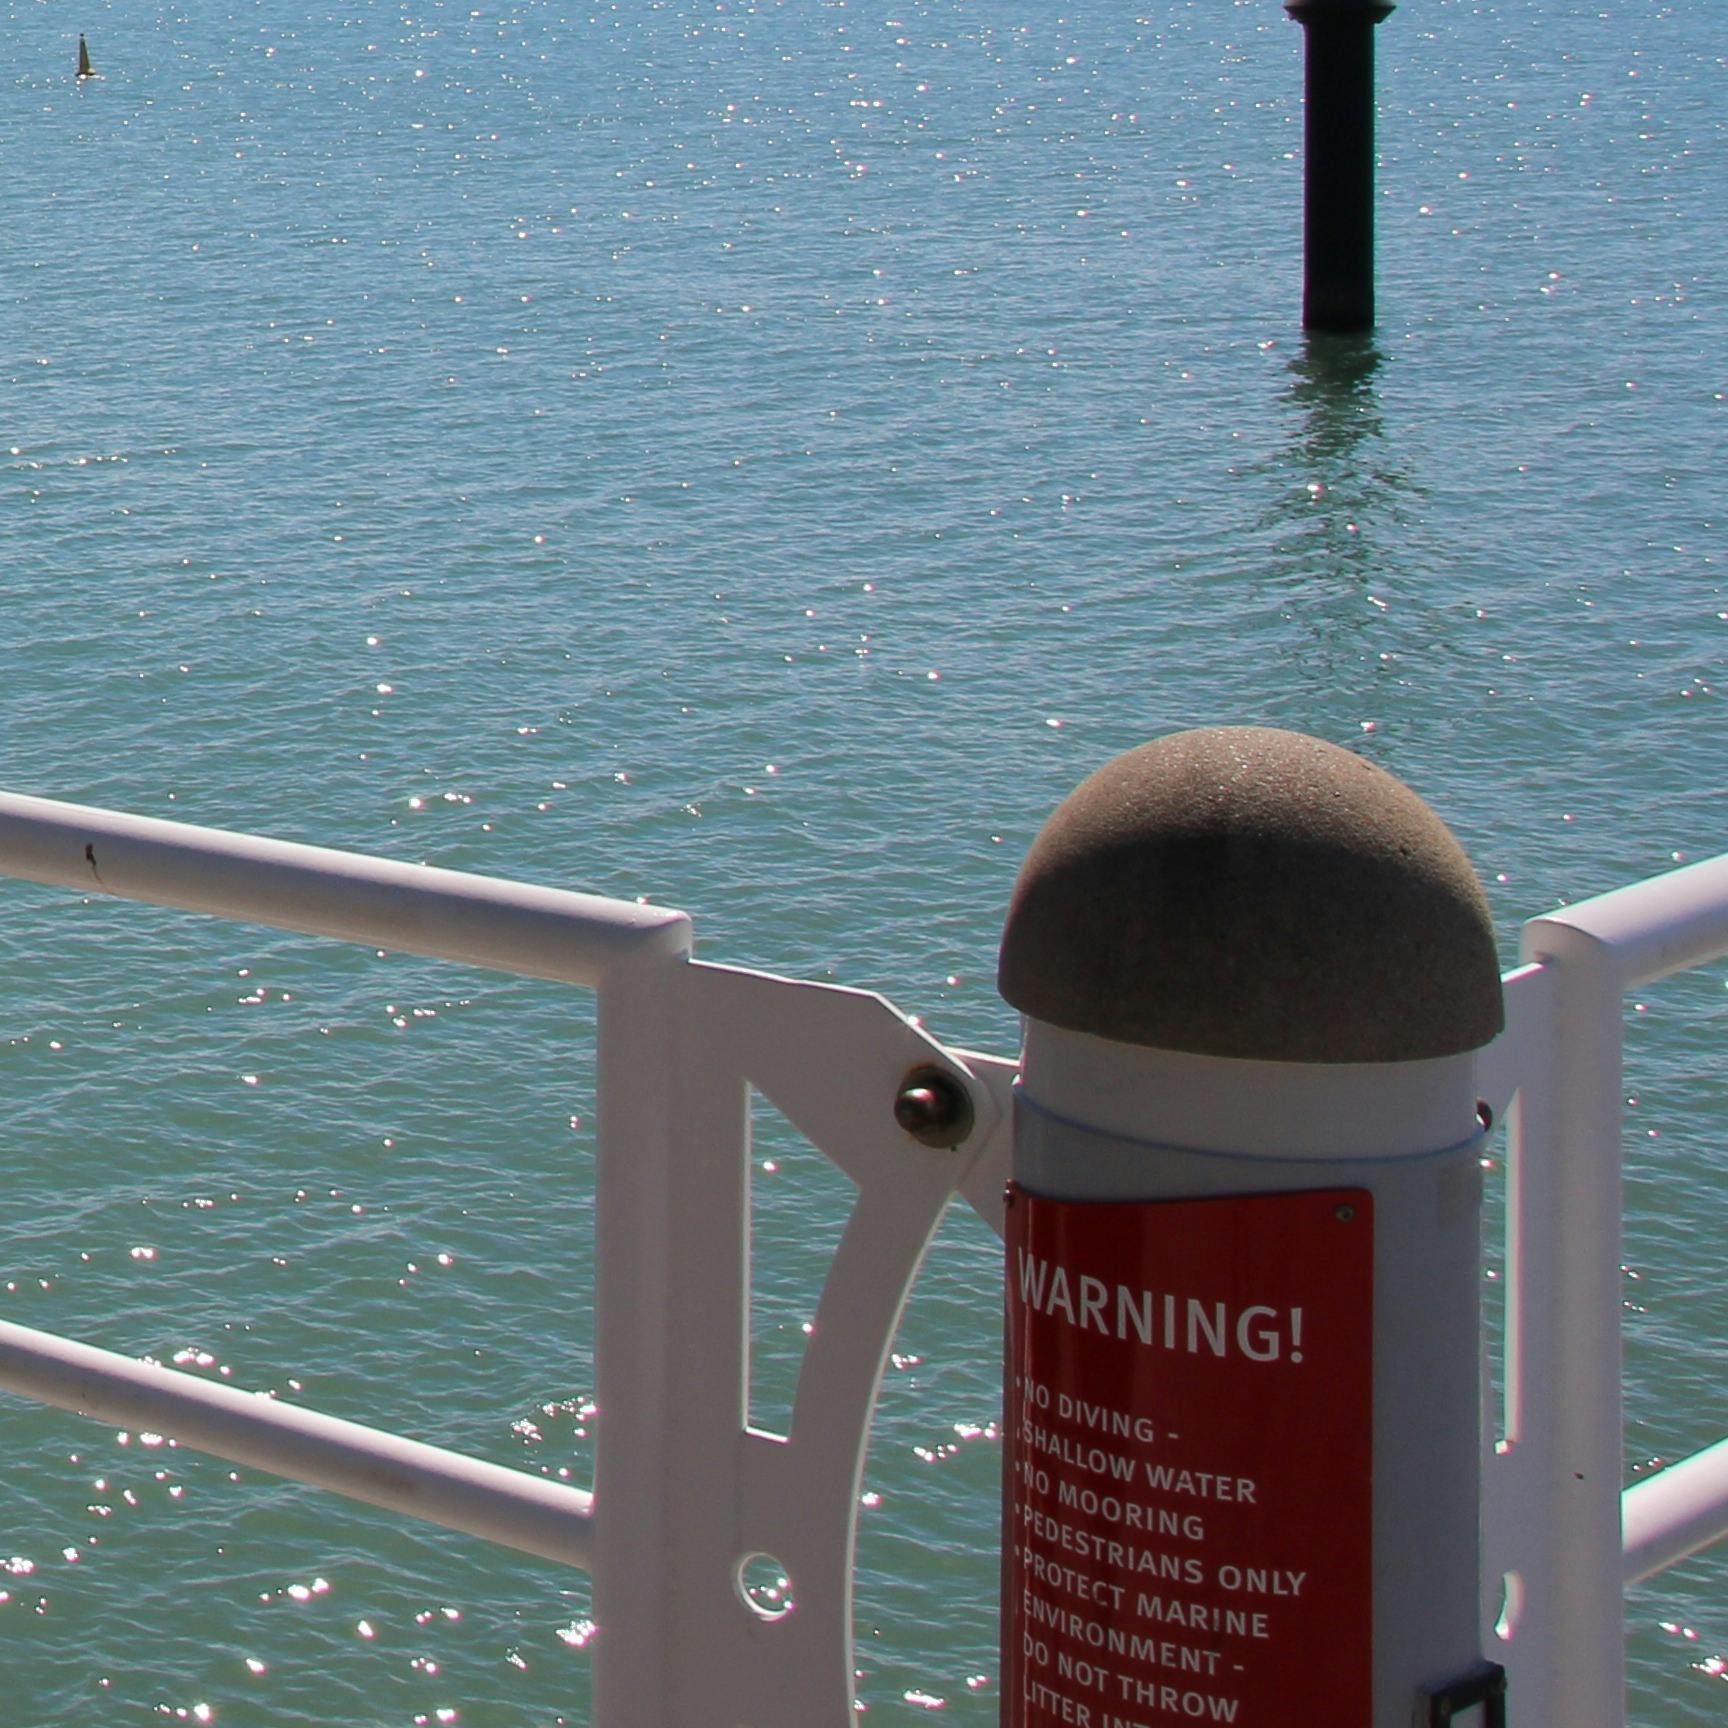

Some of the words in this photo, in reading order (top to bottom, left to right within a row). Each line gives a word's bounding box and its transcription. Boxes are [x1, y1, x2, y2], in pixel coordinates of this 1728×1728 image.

[1017, 1245, 1304, 1365] WARNING!
[1024, 1375, 1049, 1409] NO
[1058, 1392, 1154, 1443] DIVING
[1023, 1418, 1136, 1483] SHALLOW
[1145, 1462, 1257, 1504] WATER
[1024, 1461, 1049, 1495] NO
[1058, 1480, 1205, 1541] MOORING
[1023, 1503, 1204, 1585] PEDESTRIANS
[1218, 1565, 1307, 1596] ONLY
[1023, 1545, 1126, 1611] PROTECT
[1136, 1593, 1270, 1638] MARINE
[1023, 1588, 1221, 1676] ENVIRONMENT
[1023, 1631, 1049, 1666] DO
[1058, 1652, 1109, 1692] NOT
[1117, 1674, 1239, 1723] THROW
[1023, 1674, 1091, 1728] LITTER
